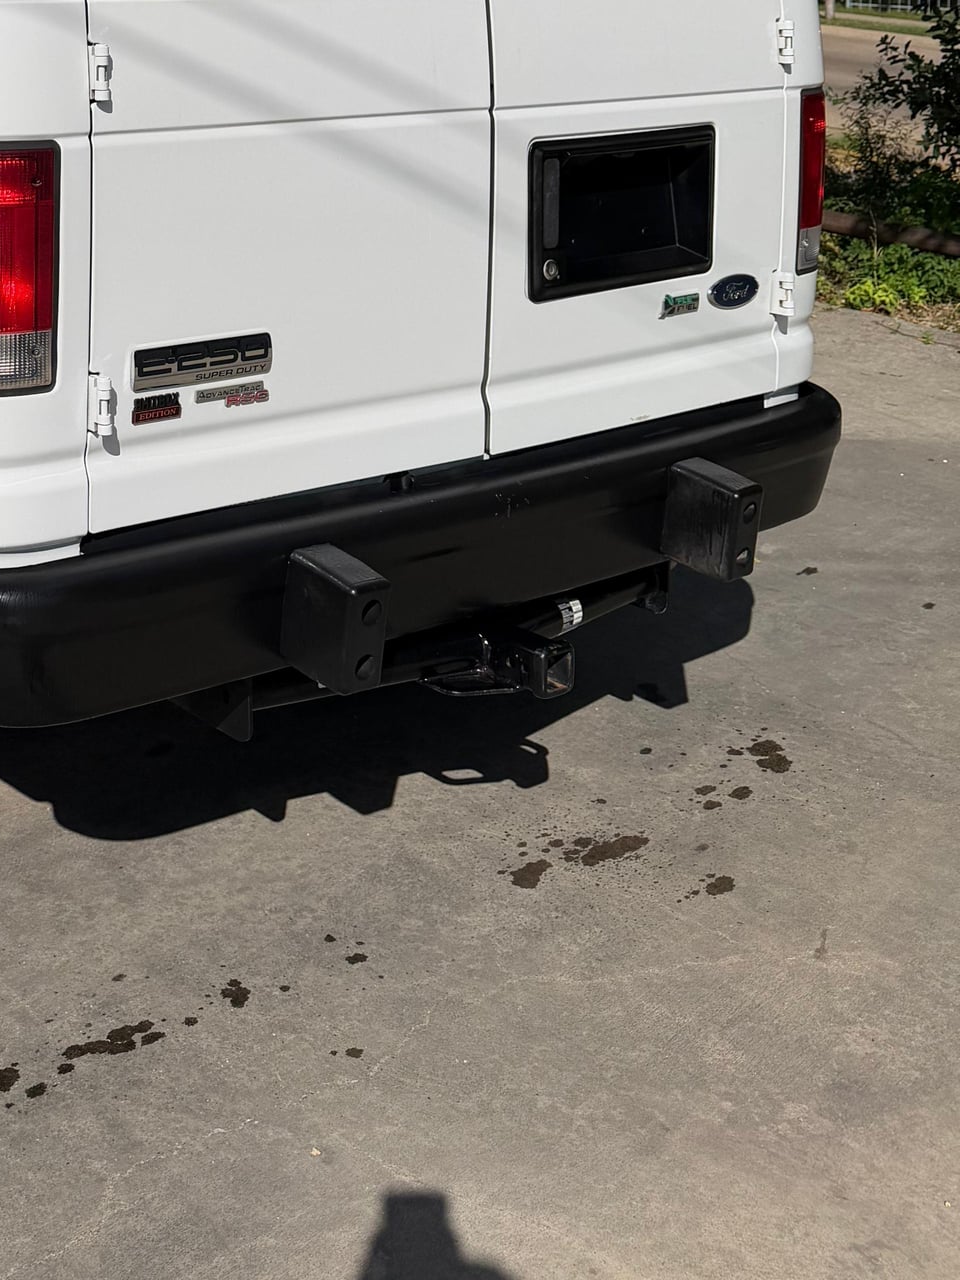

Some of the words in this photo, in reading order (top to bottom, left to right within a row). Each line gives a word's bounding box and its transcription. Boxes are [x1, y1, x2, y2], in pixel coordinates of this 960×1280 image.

[722, 282, 749, 301] Ford
[195, 369, 233, 380] SUPER
[236, 363, 267, 374] DUTY
[225, 390, 269, 408] RSC
[139, 408, 176, 420] EDITION
